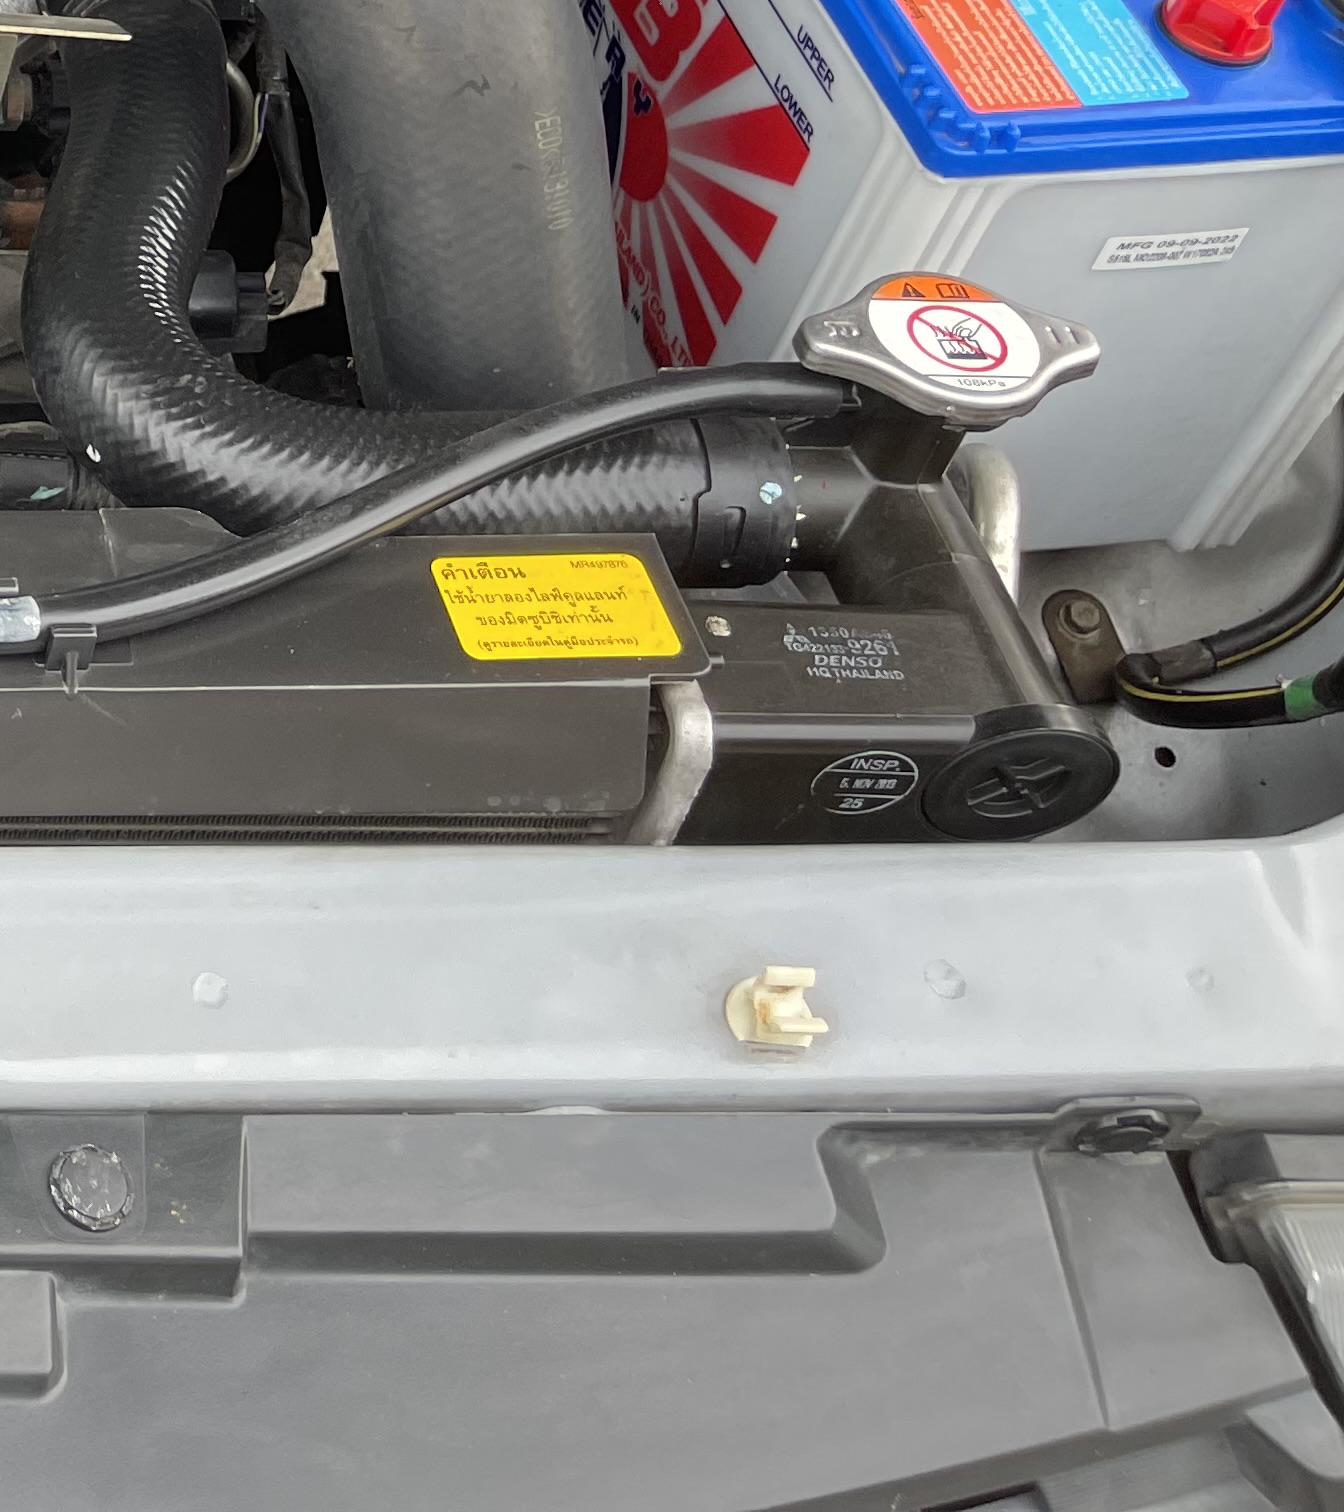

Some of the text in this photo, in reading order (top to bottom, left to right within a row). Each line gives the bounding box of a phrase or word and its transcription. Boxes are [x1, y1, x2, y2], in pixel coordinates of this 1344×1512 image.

[797, 24, 835, 91] UPPER
[774, 74, 814, 143] LOWER
[1116, 234, 1239, 251] MFG 09-09-2022
[956, 376, 1007, 388] 108kPa
[441, 562, 527, 581] คำเตือน
[814, 654, 883, 668] DENSO
[850, 758, 900, 772] INSP.
[839, 797, 865, 809] 25
